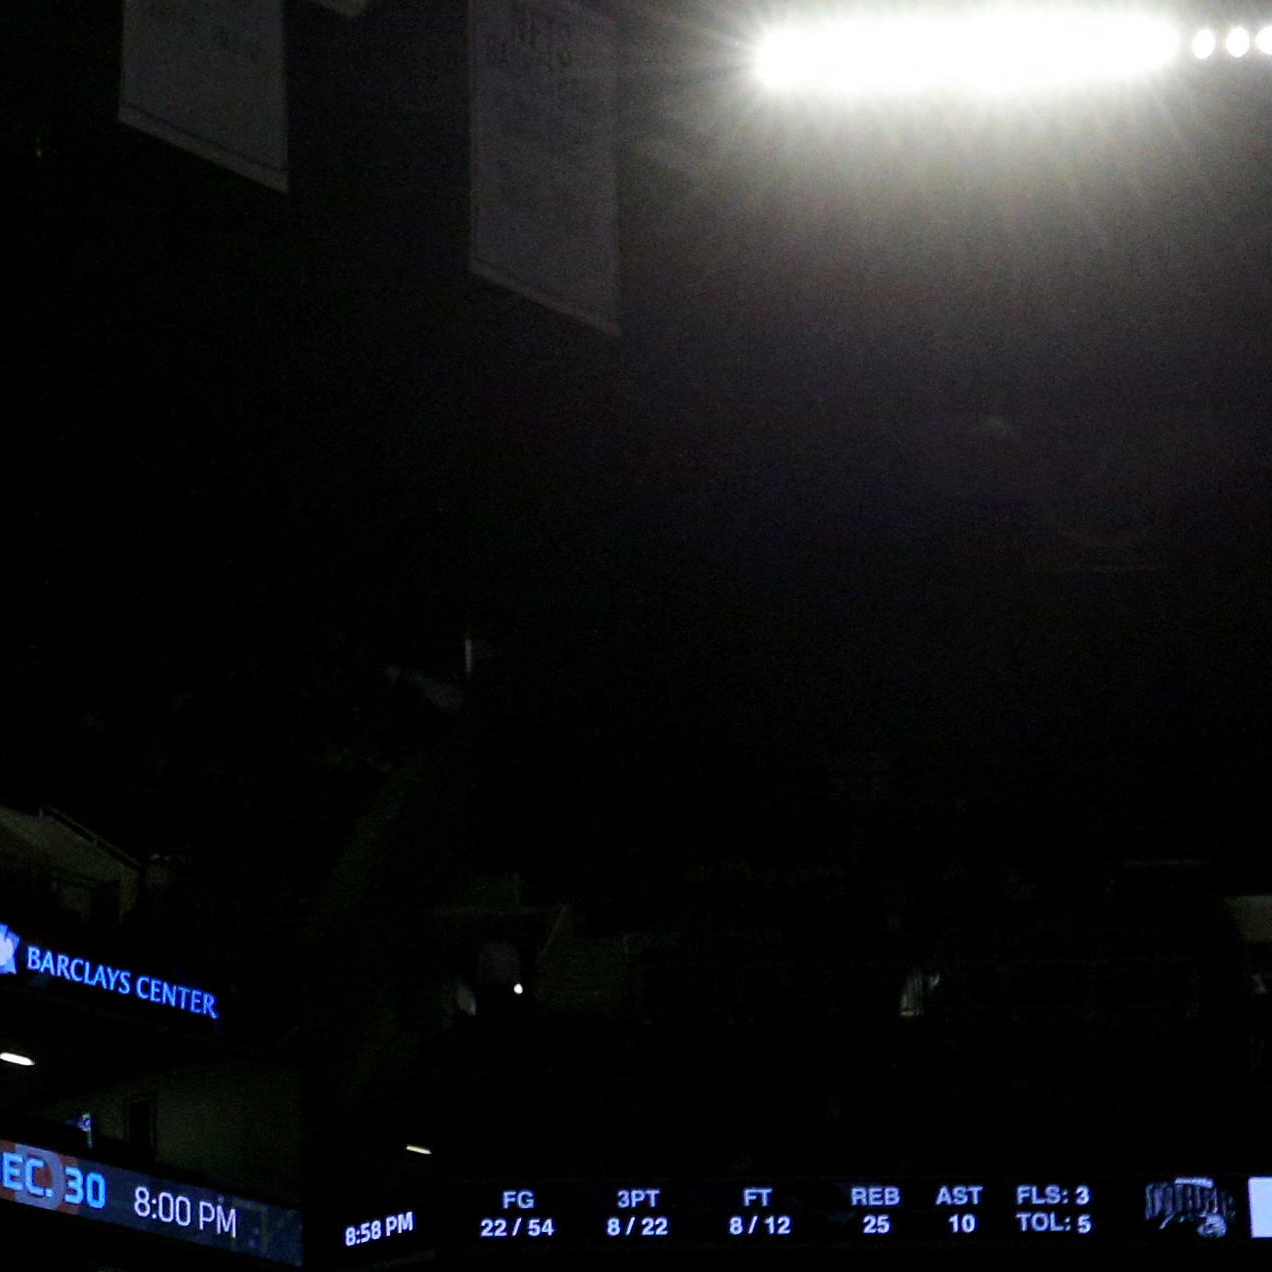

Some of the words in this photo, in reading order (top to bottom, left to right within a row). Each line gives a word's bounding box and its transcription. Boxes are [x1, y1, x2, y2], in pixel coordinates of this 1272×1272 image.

[26, 945, 132, 995] BARCLAYS
[135, 976, 219, 1019] CENTER
[63, 1164, 106, 1209] 30
[134, 1186, 192, 1228] 8:00
[199, 1201, 237, 1239] PM
[502, 1190, 535, 1209] FG
[617, 1188, 660, 1208] 3PT
[742, 1188, 773, 1207] FT
[851, 1185, 900, 1206] REB
[935, 1185, 983, 1206] AST
[1016, 1185, 1070, 1205] FLS:
[1074, 1185, 1090, 1206] 3
[345, 1218, 383, 1247] 8:58
[385, 1210, 414, 1236] PM
[480, 1219, 508, 1237] 22
[528, 1219, 555, 1237] 54
[607, 1218, 620, 1237] 8
[641, 1218, 669, 1237] 22
[728, 1217, 743, 1236] 8
[765, 1216, 792, 1236] 12
[862, 1214, 891, 1235] 25
[948, 1213, 976, 1233] 10
[1016, 1212, 1072, 1233] TOL:
[1076, 1214, 1092, 1234] 5
